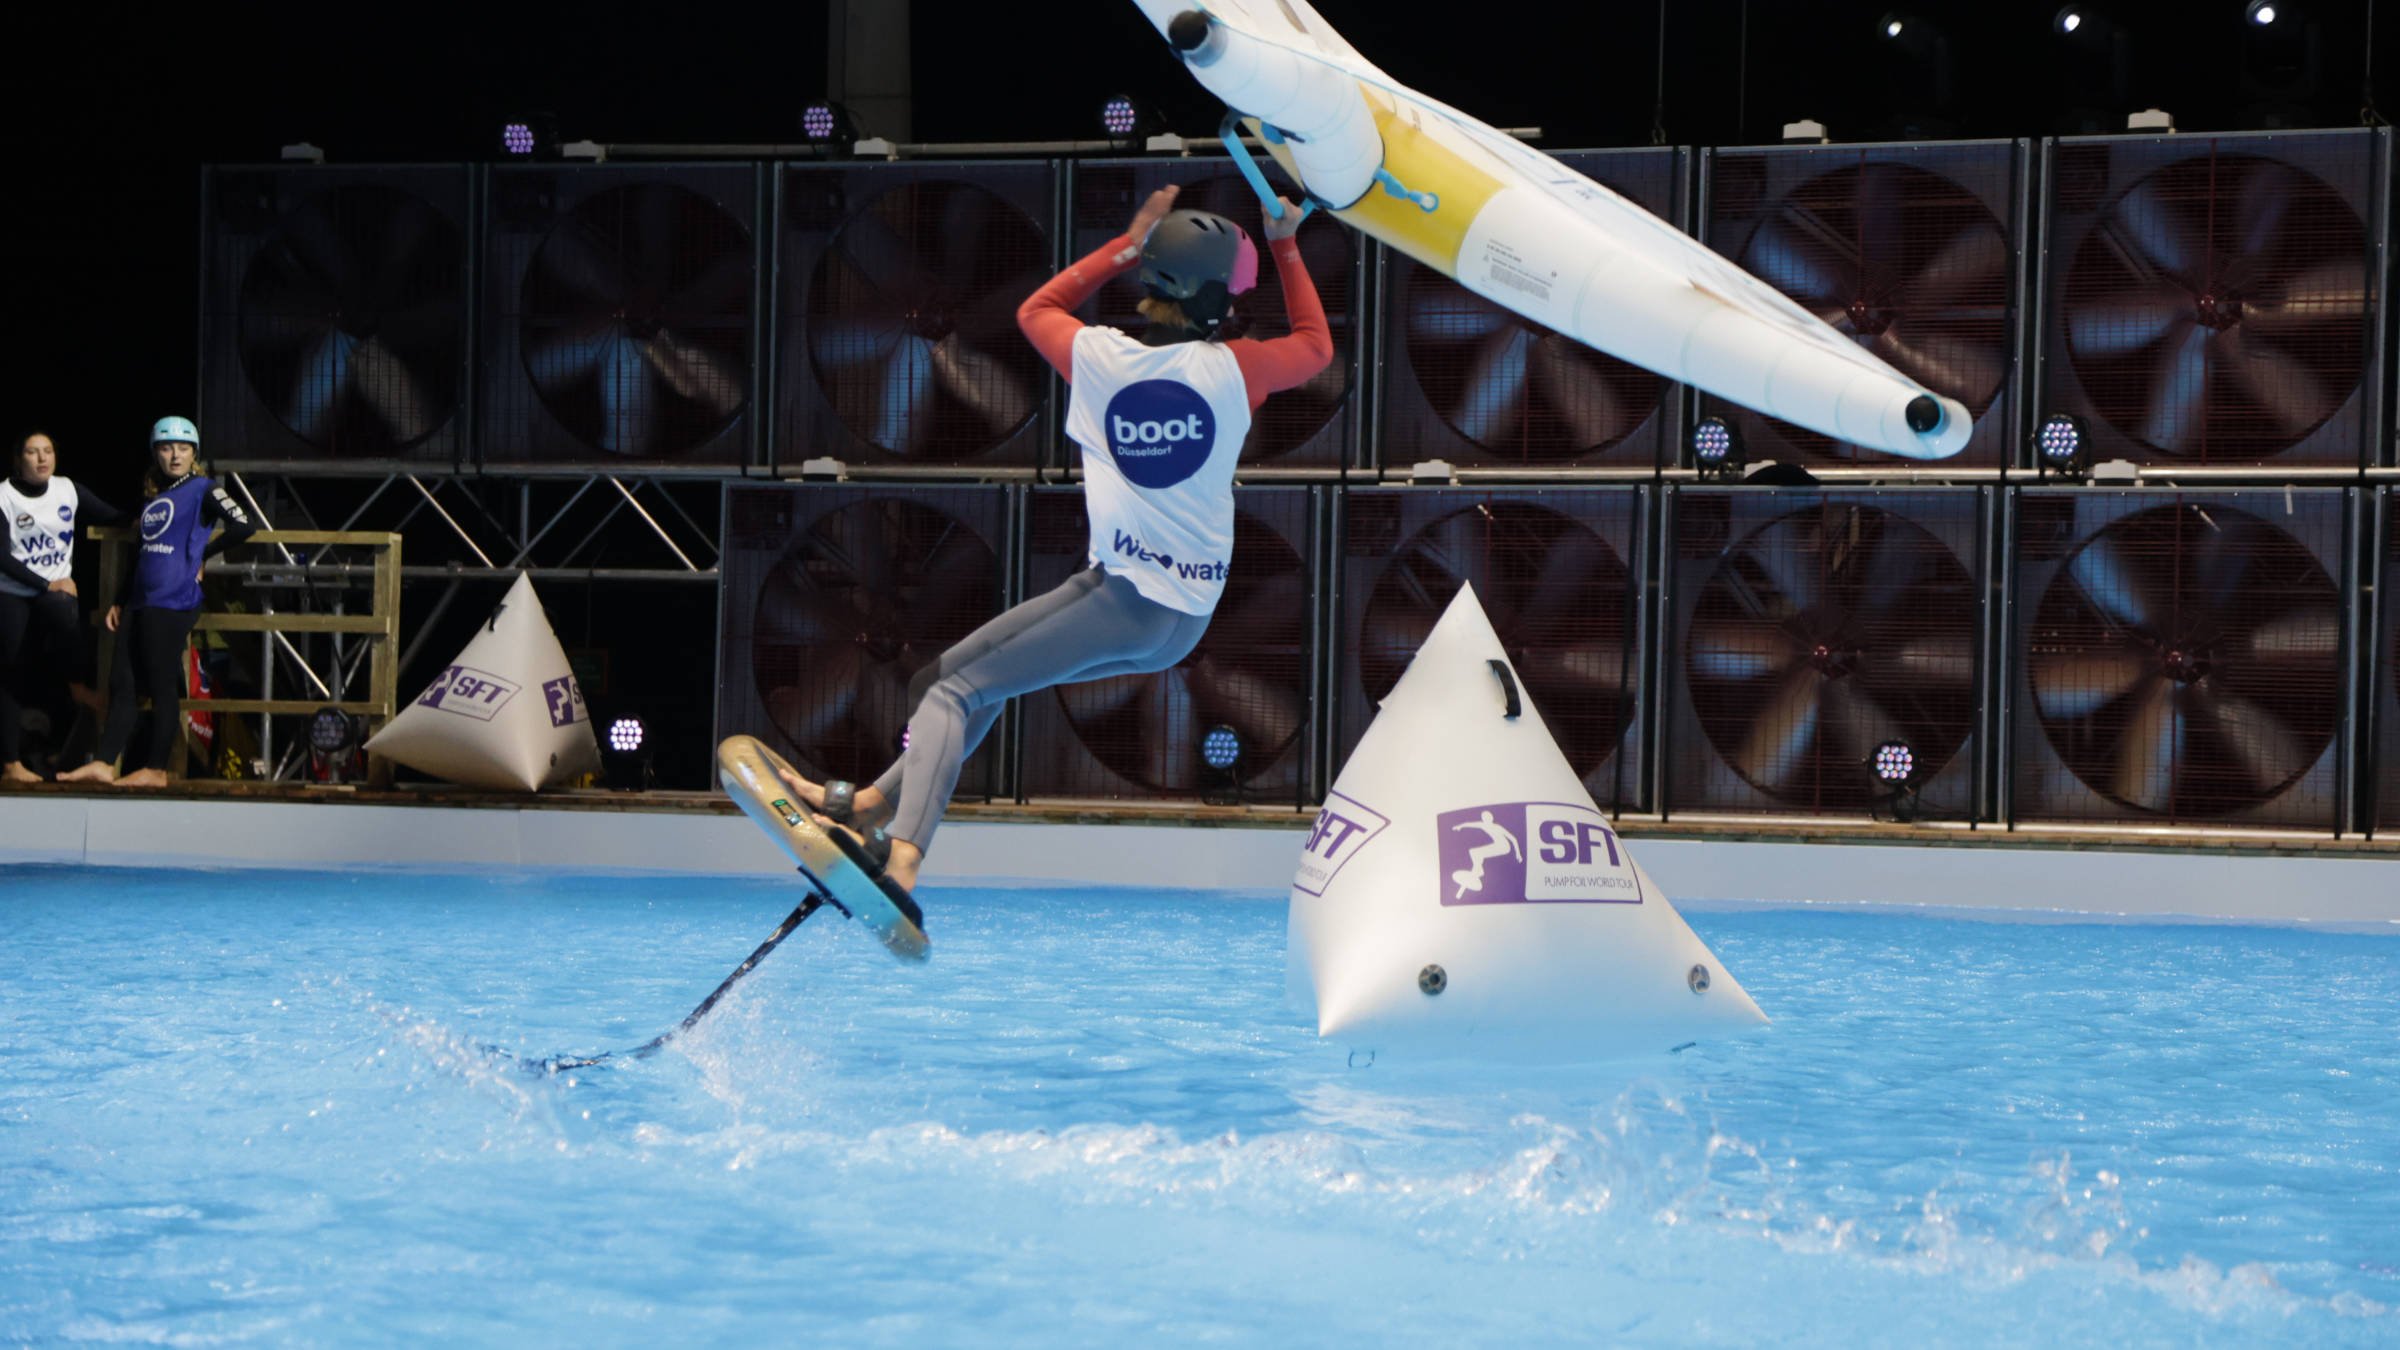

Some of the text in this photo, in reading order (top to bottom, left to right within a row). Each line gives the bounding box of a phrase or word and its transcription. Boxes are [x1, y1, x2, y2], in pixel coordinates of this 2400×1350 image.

[1113, 413, 1204, 444] boot
[1117, 444, 1172, 457] Düsseldorf
[20, 531, 56, 553] We
[453, 676, 510, 704] SFT
[1304, 808, 1368, 860] SFT
[1539, 820, 1621, 867] SFT
[1544, 875, 1635, 890] PUMP FOIL WORLD TOUR
